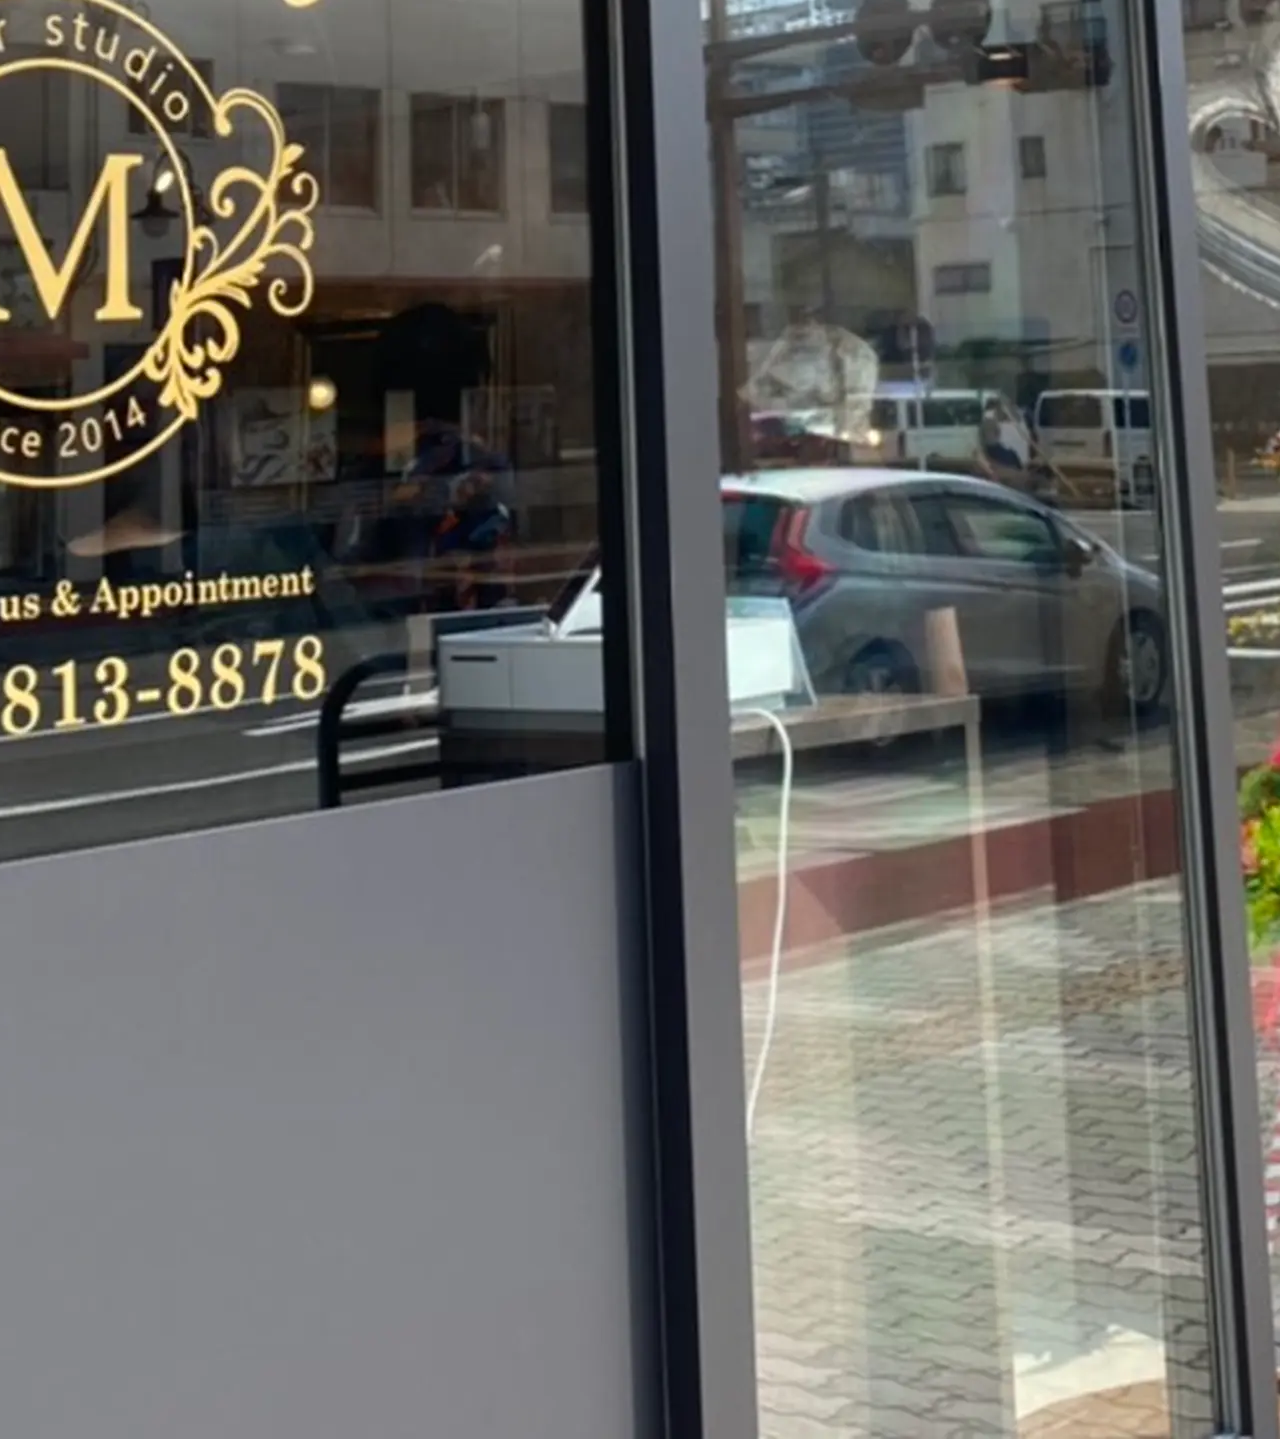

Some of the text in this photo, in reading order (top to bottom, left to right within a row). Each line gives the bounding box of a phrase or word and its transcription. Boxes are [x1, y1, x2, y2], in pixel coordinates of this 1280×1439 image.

[45, 12, 190, 121] studio
[58, 395, 147, 457] 2014
[50, 579, 82, 617] &
[89, 564, 316, 619] Appointment
